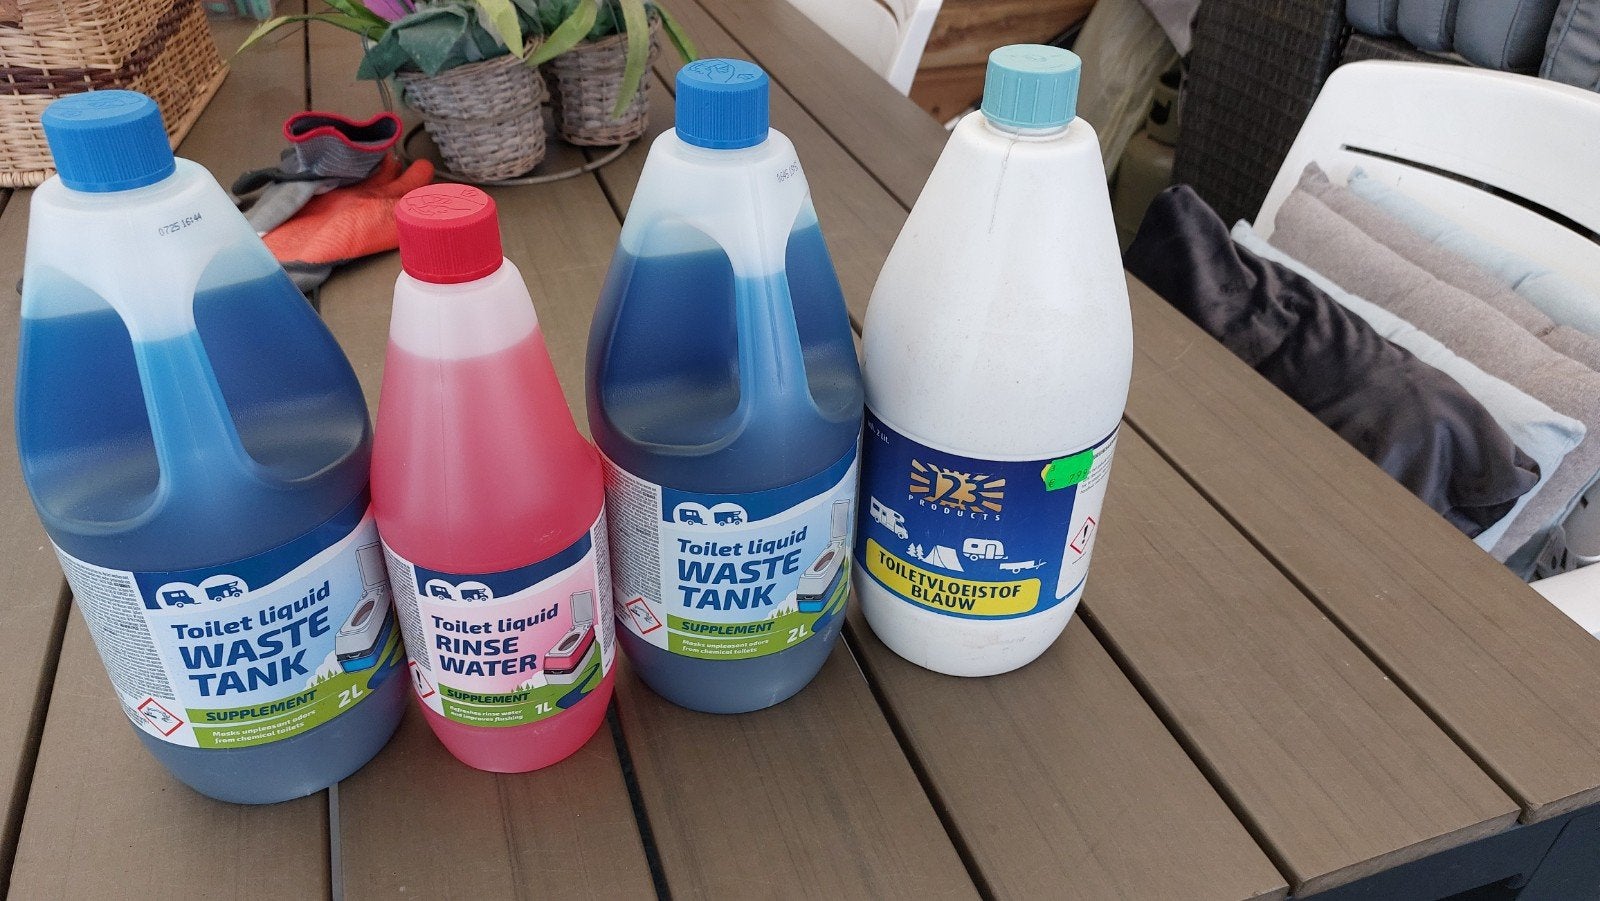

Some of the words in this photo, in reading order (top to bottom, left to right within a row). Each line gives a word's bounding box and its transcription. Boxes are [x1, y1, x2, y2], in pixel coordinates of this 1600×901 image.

[908, 494, 1000, 521] PRODUCTS
[677, 538, 743, 557] Toilet
[747, 525, 808, 555] liquid
[677, 548, 802, 585] WASTE
[879, 550, 1022, 599] TOILETVLOEISTOF
[677, 582, 777, 611] TANK
[911, 584, 976, 611] BLAUW
[171, 616, 253, 640] Toilet
[259, 580, 331, 626] liquid
[431, 615, 492, 635] Toilet
[498, 603, 559, 632] liquid
[178, 605, 331, 670] WASTE
[681, 620, 775, 635] SUPPLEMENT
[786, 622, 808, 644] 2L
[435, 633, 519, 656] RINSE
[682, 639, 706, 648] Masks
[706, 641, 748, 651] unpleasant
[748, 639, 770, 648] odors
[682, 646, 700, 654] from
[700, 647, 733, 655] chemical
[733, 646, 758, 655] toilets
[188, 648, 309, 697] TANK
[439, 653, 537, 677] WATER
[206, 689, 318, 722] SUPPLEMENT
[338, 683, 363, 709] 2L
[446, 688, 531, 705] SUPPLEMENT
[534, 701, 553, 715] 1L
[212, 729, 241, 738] Masks
[242, 718, 292, 736] unpleasant
[292, 709, 317, 722] odors
[494, 713, 524, 723] flushing
[501, 709, 523, 717] water
[214, 737, 236, 745] from
[236, 731, 276, 743] chemical
[277, 721, 305, 735] toilets
